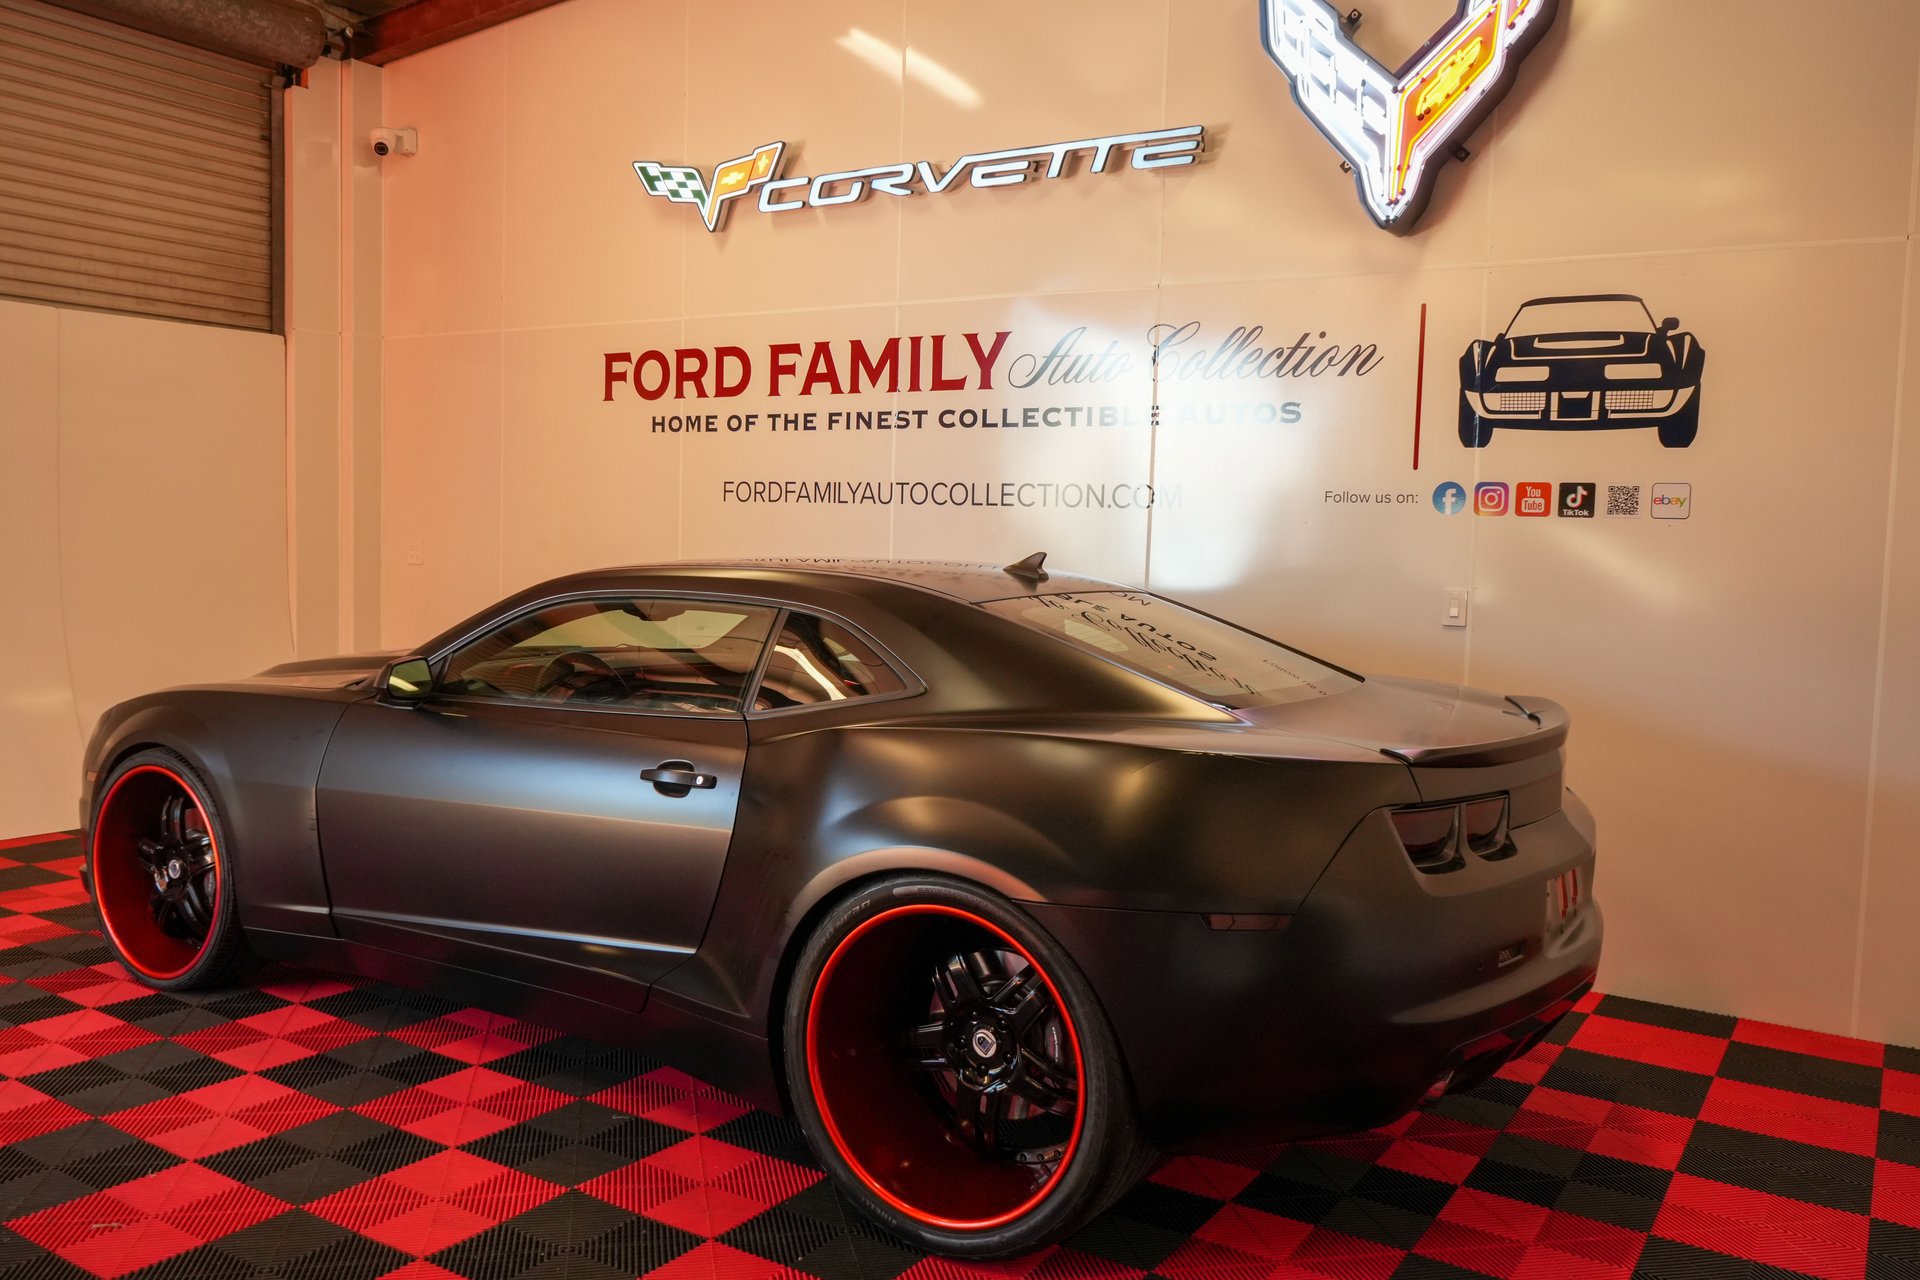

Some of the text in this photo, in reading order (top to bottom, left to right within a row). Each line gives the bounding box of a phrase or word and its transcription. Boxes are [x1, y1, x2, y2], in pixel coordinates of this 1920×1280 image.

[758, 125, 1204, 213] CORVETTE
[603, 321, 1384, 401] FORD FAMILY Auto Collection
[652, 401, 1302, 433] HOME OF THE FINEST COLLECTIBLE AUTOS
[724, 481, 1182, 509] FORDFAMILYAUTOCOLLECTION.COM
[1325, 490, 1419, 504] Follow us on:
[1526, 486, 1541, 497] You
[1524, 500, 1543, 511] Tube
[1653, 496, 1687, 508] ebay
[1562, 508, 1589, 516] TikTok
